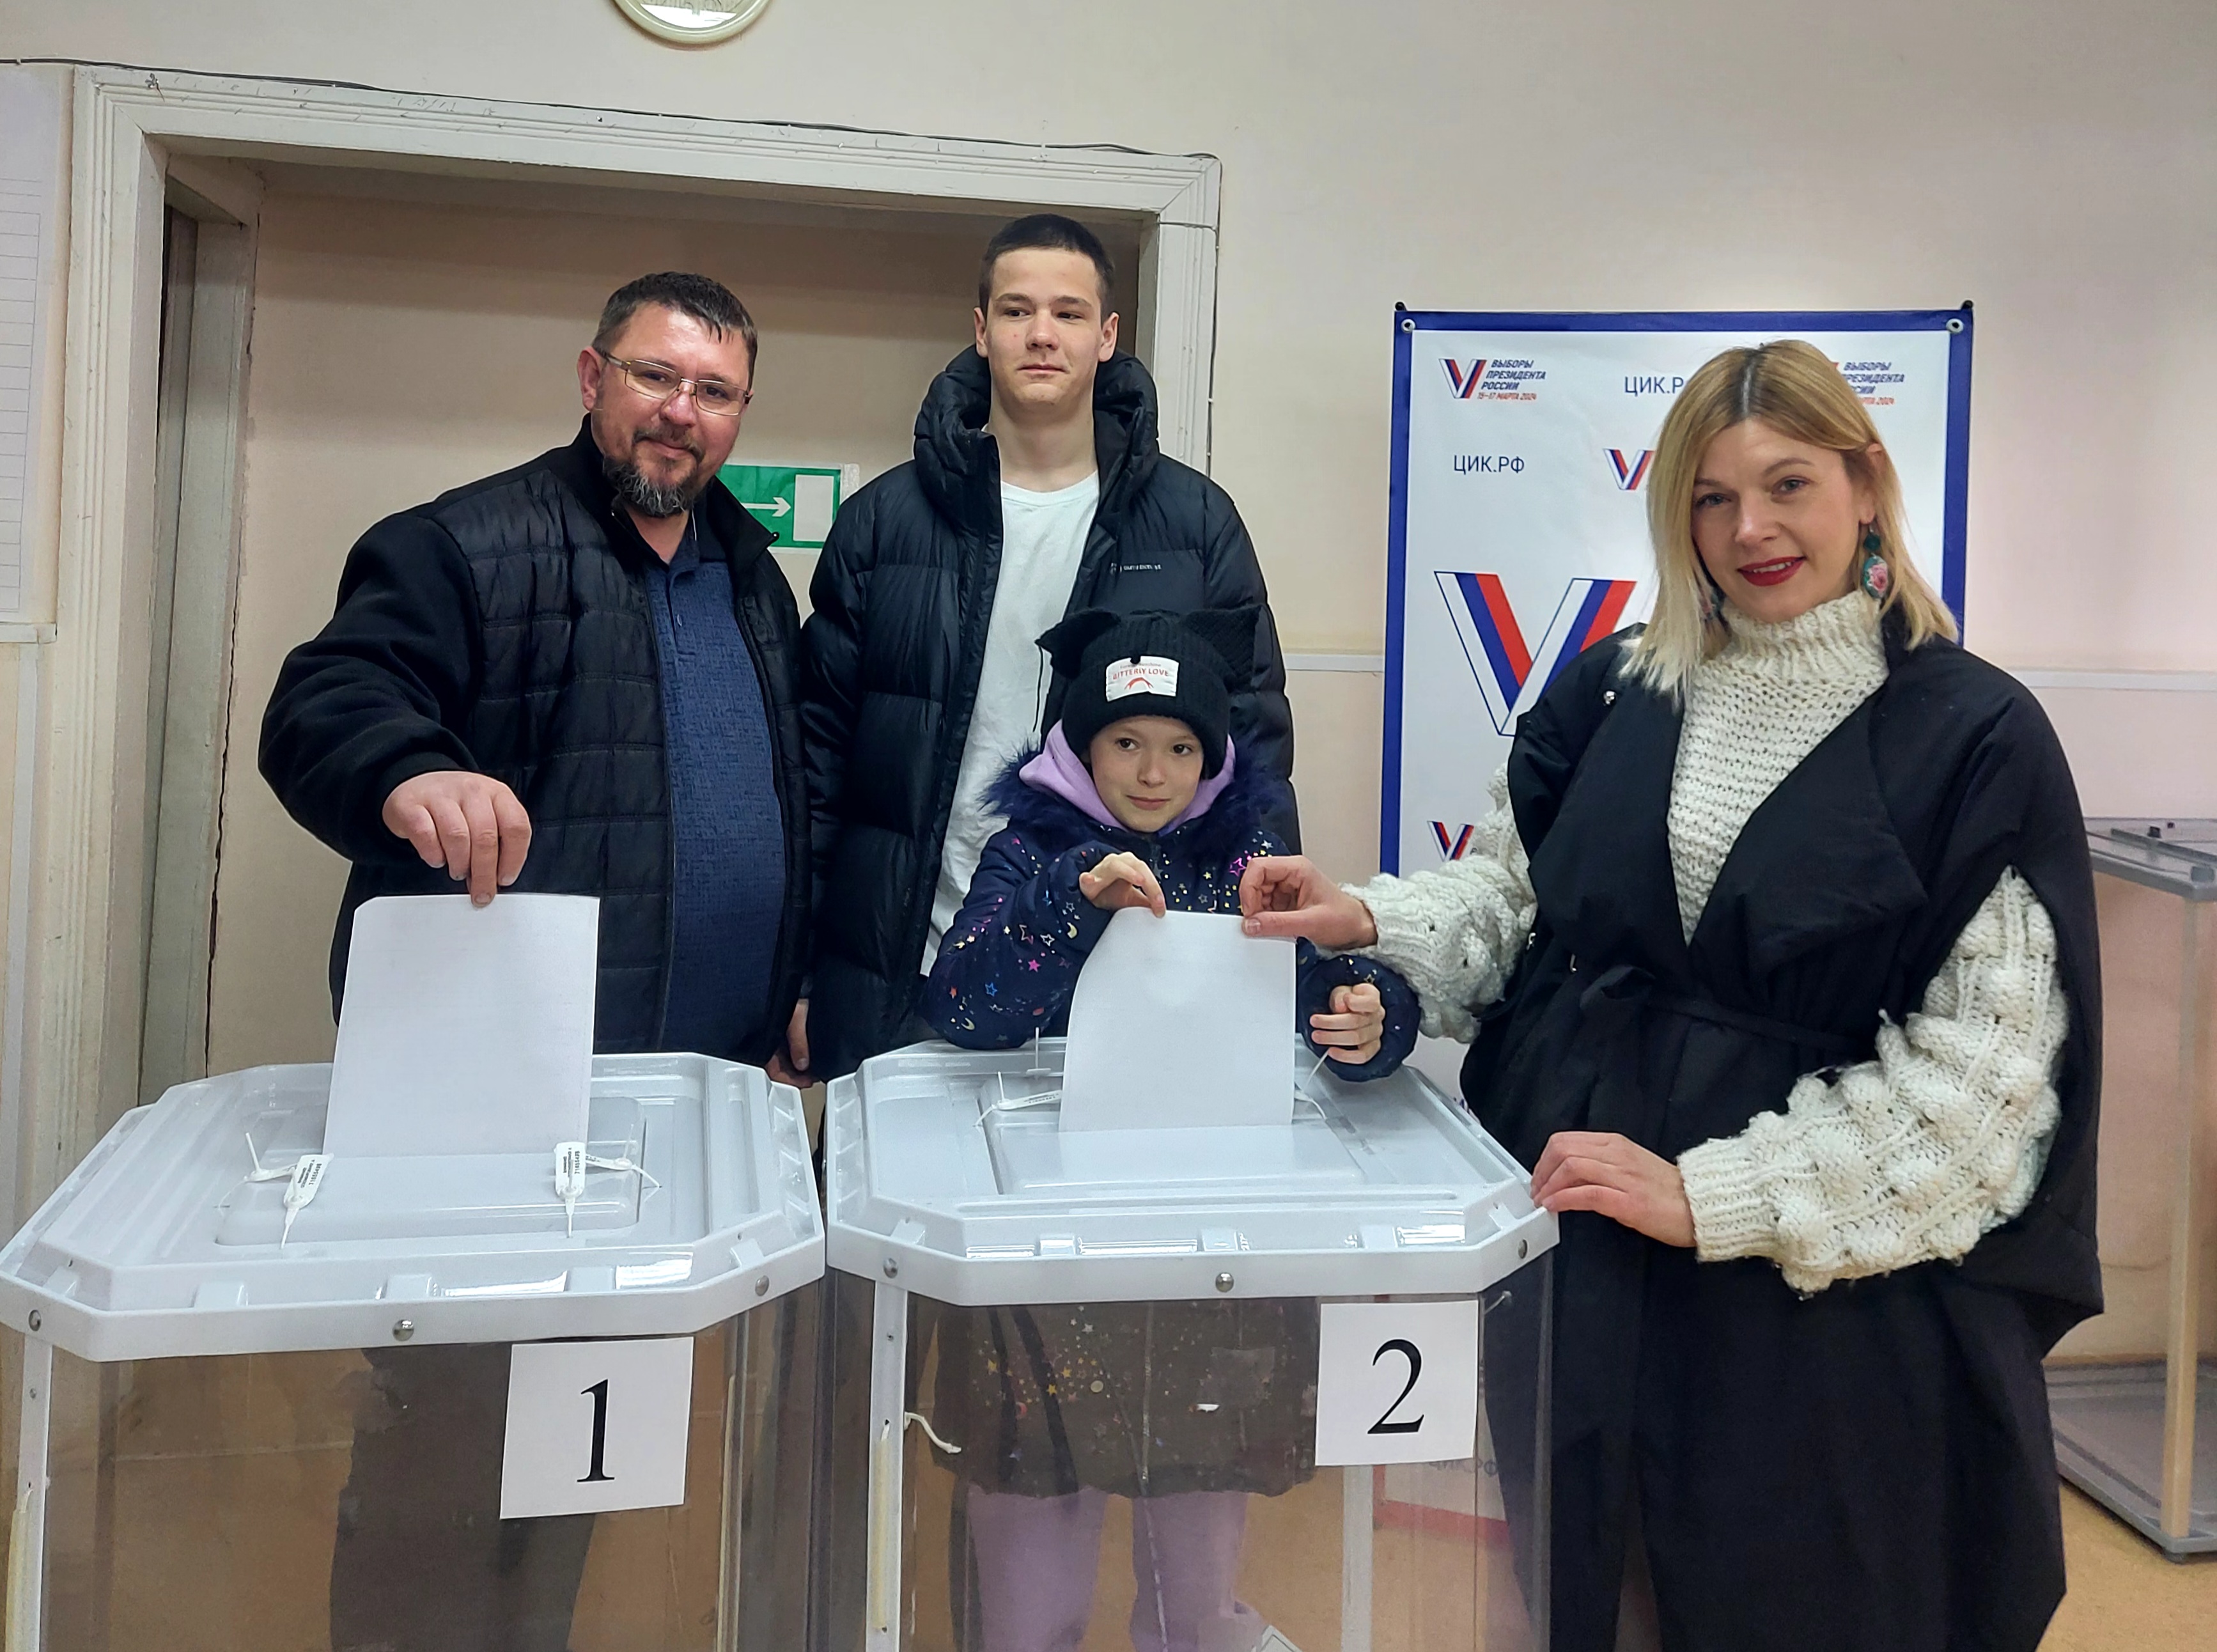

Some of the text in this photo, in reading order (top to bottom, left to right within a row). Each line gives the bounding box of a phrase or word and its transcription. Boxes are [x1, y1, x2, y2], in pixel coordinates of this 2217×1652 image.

[1491, 359, 1534, 368] ВЫБОРЫ
[1486, 370, 1546, 380] ПРЕЗИДЕНТА
[1481, 382, 1520, 391] РОССИИ
[1624, 376, 1684, 397] ЦИК.Р
[1454, 455, 1525, 475] ЦИК.РФ
[1148, 668, 1169, 677] LOVE
[1367, 1339, 1424, 1434] 2
[577, 1378, 615, 1483] 1
